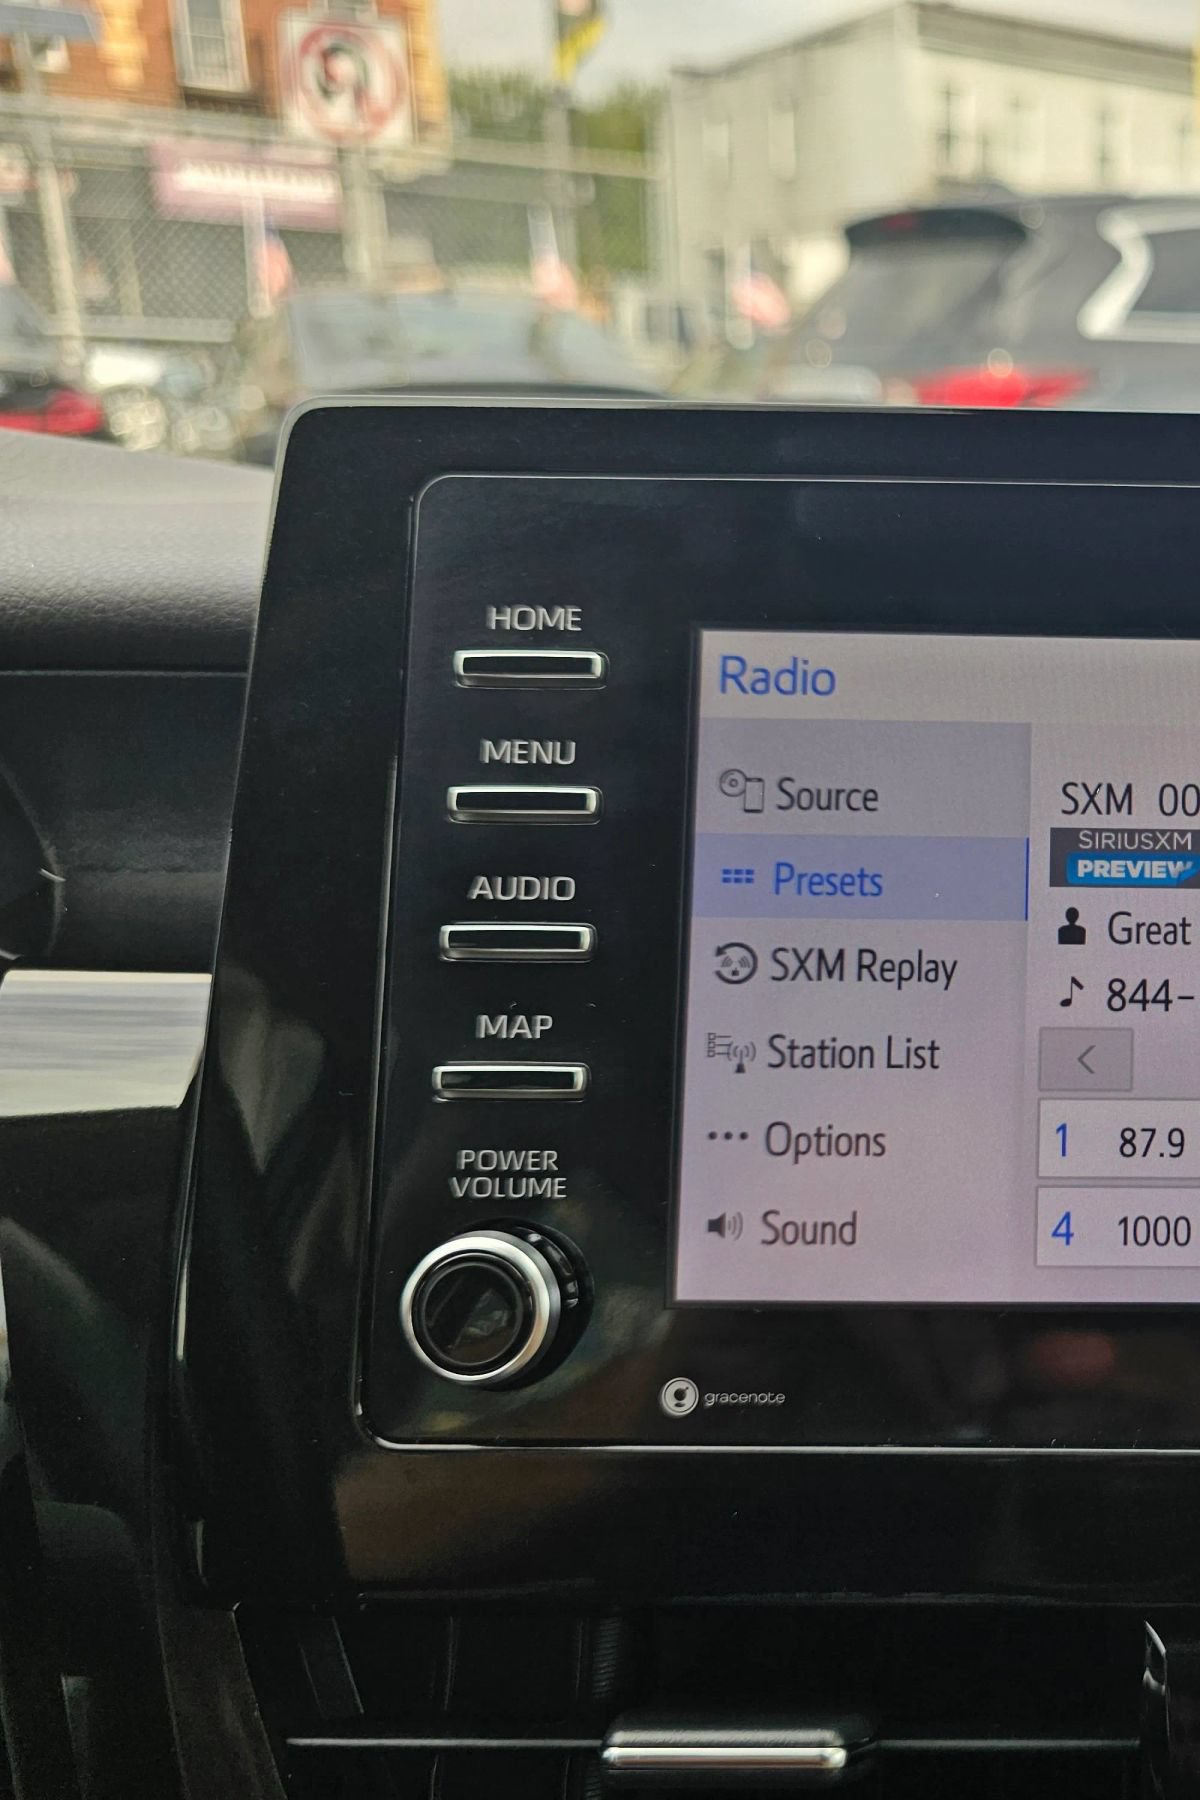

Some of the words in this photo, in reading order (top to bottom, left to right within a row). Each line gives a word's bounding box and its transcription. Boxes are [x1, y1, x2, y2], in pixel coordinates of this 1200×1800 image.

[486, 606, 583, 631] HOME
[719, 654, 837, 697] Radio
[479, 739, 577, 765] MENU
[776, 777, 879, 812] Source
[1060, 782, 1134, 817] SXM
[1078, 830, 1193, 851] SIRIUSXM
[773, 860, 884, 898] Presets
[1076, 859, 1194, 880] PREVIEW
[467, 875, 577, 901] AUDIO
[1107, 911, 1193, 947] Great
[769, 946, 845, 983] SXM
[855, 947, 958, 991] Replay
[475, 1014, 554, 1040] MAP
[767, 1034, 876, 1071] Station
[885, 1036, 941, 1071] List
[764, 1121, 888, 1165] Options
[1054, 1122, 1070, 1158] 1
[1117, 1127, 1187, 1160] 87.9
[456, 1149, 559, 1172] POWER
[449, 1176, 568, 1199] VOLUME
[760, 1209, 858, 1247] Sound
[1051, 1212, 1075, 1247] 4
[1116, 1215, 1193, 1248] 1000
[703, 1389, 786, 1407] gracenote
